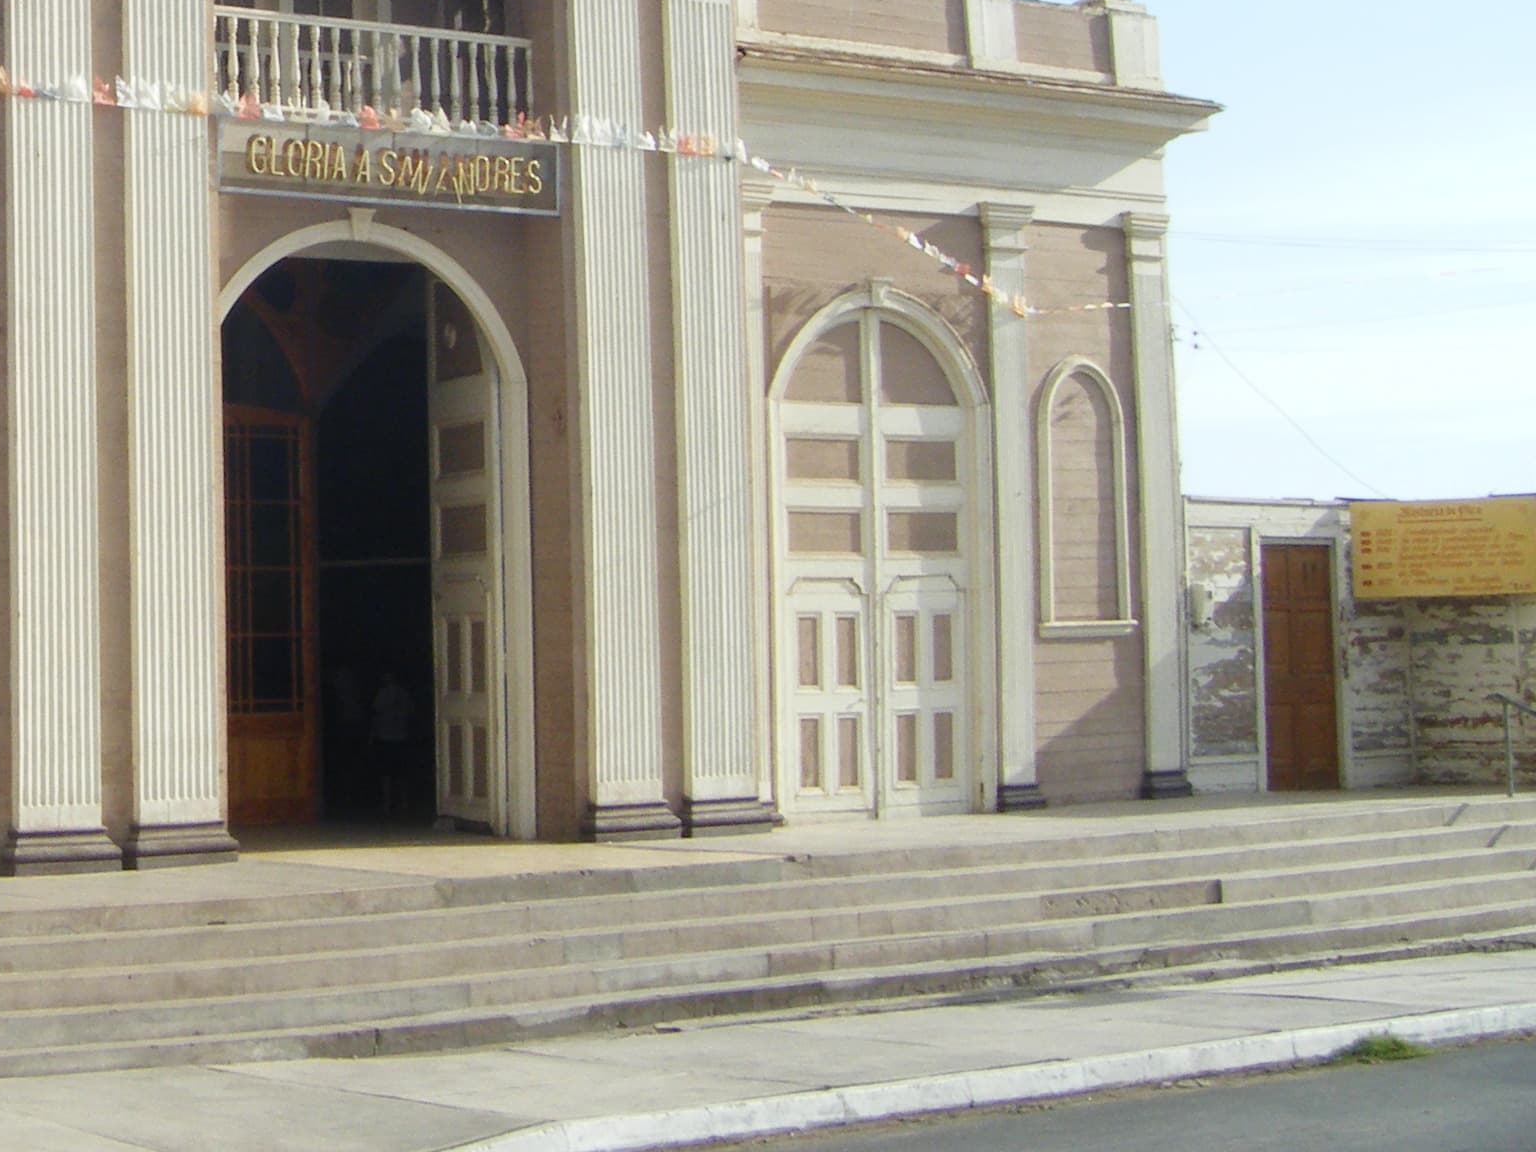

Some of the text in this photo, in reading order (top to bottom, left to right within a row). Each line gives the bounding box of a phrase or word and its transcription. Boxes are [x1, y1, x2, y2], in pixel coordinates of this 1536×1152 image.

[247, 135, 543, 205] GLORIA A SAN ANDRES
